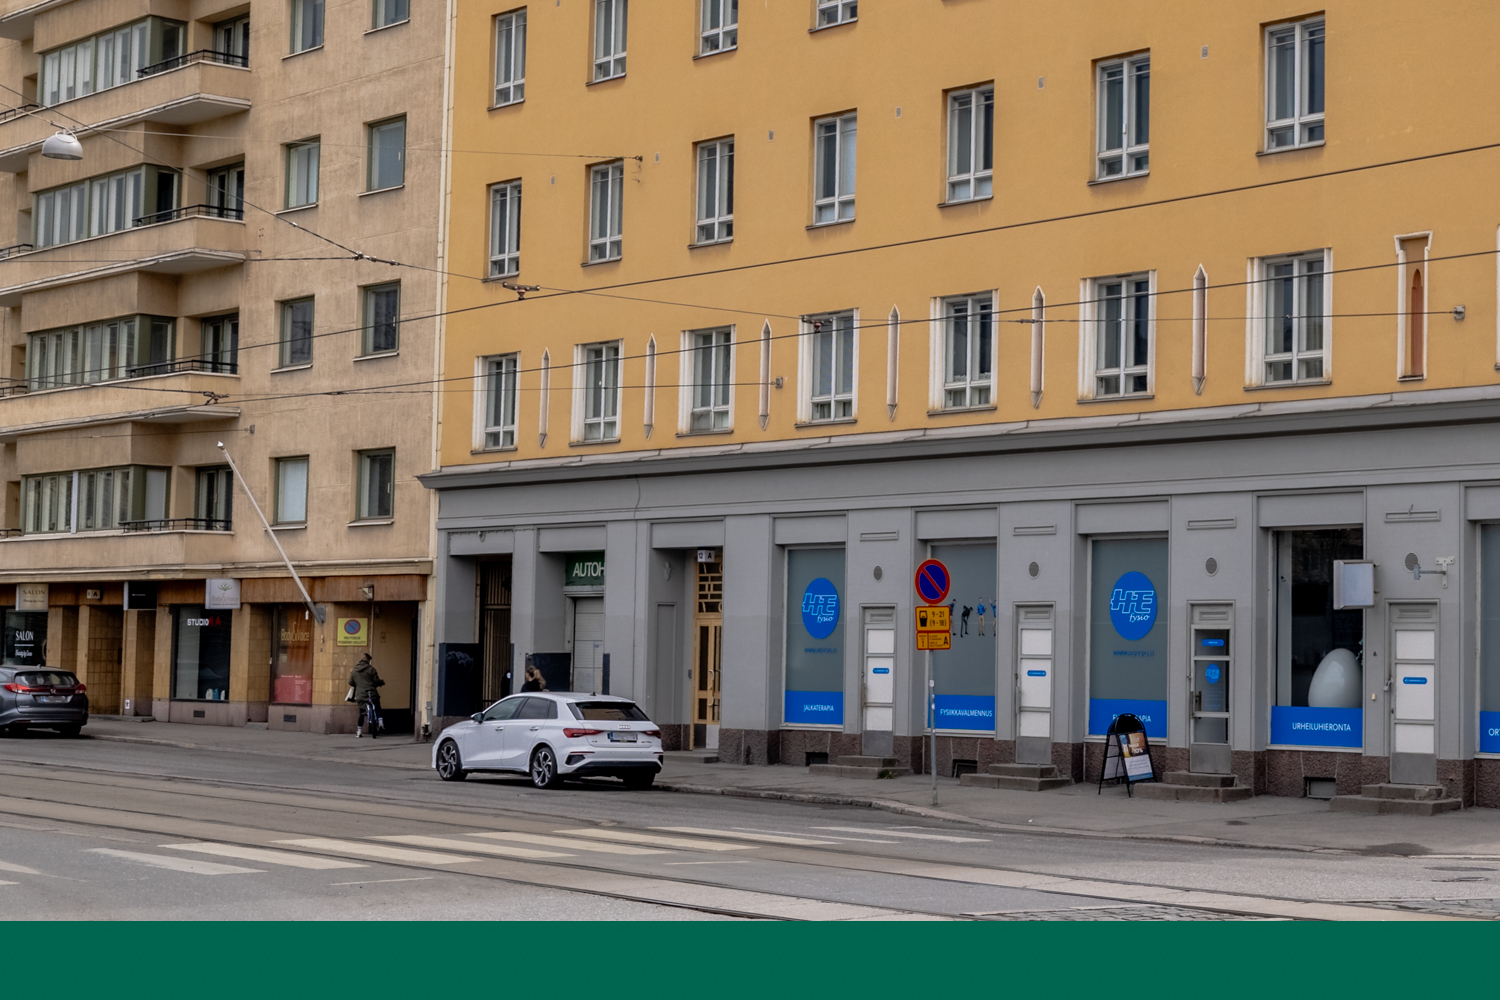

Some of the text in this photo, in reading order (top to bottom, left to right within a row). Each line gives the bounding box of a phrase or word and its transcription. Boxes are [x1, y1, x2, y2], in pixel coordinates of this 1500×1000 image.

[187, 618, 209, 626] STUDIO
[816, 614, 834, 624] fysio
[1129, 612, 1151, 623] fysio
[15, 630, 34, 641] SALON
[943, 636, 949, 646] A
[803, 704, 835, 713] JALKATERAPIA
[939, 708, 993, 717] FYSIIKKAVALMENNUS
[1292, 722, 1351, 732] URHEILUHIERONTA
